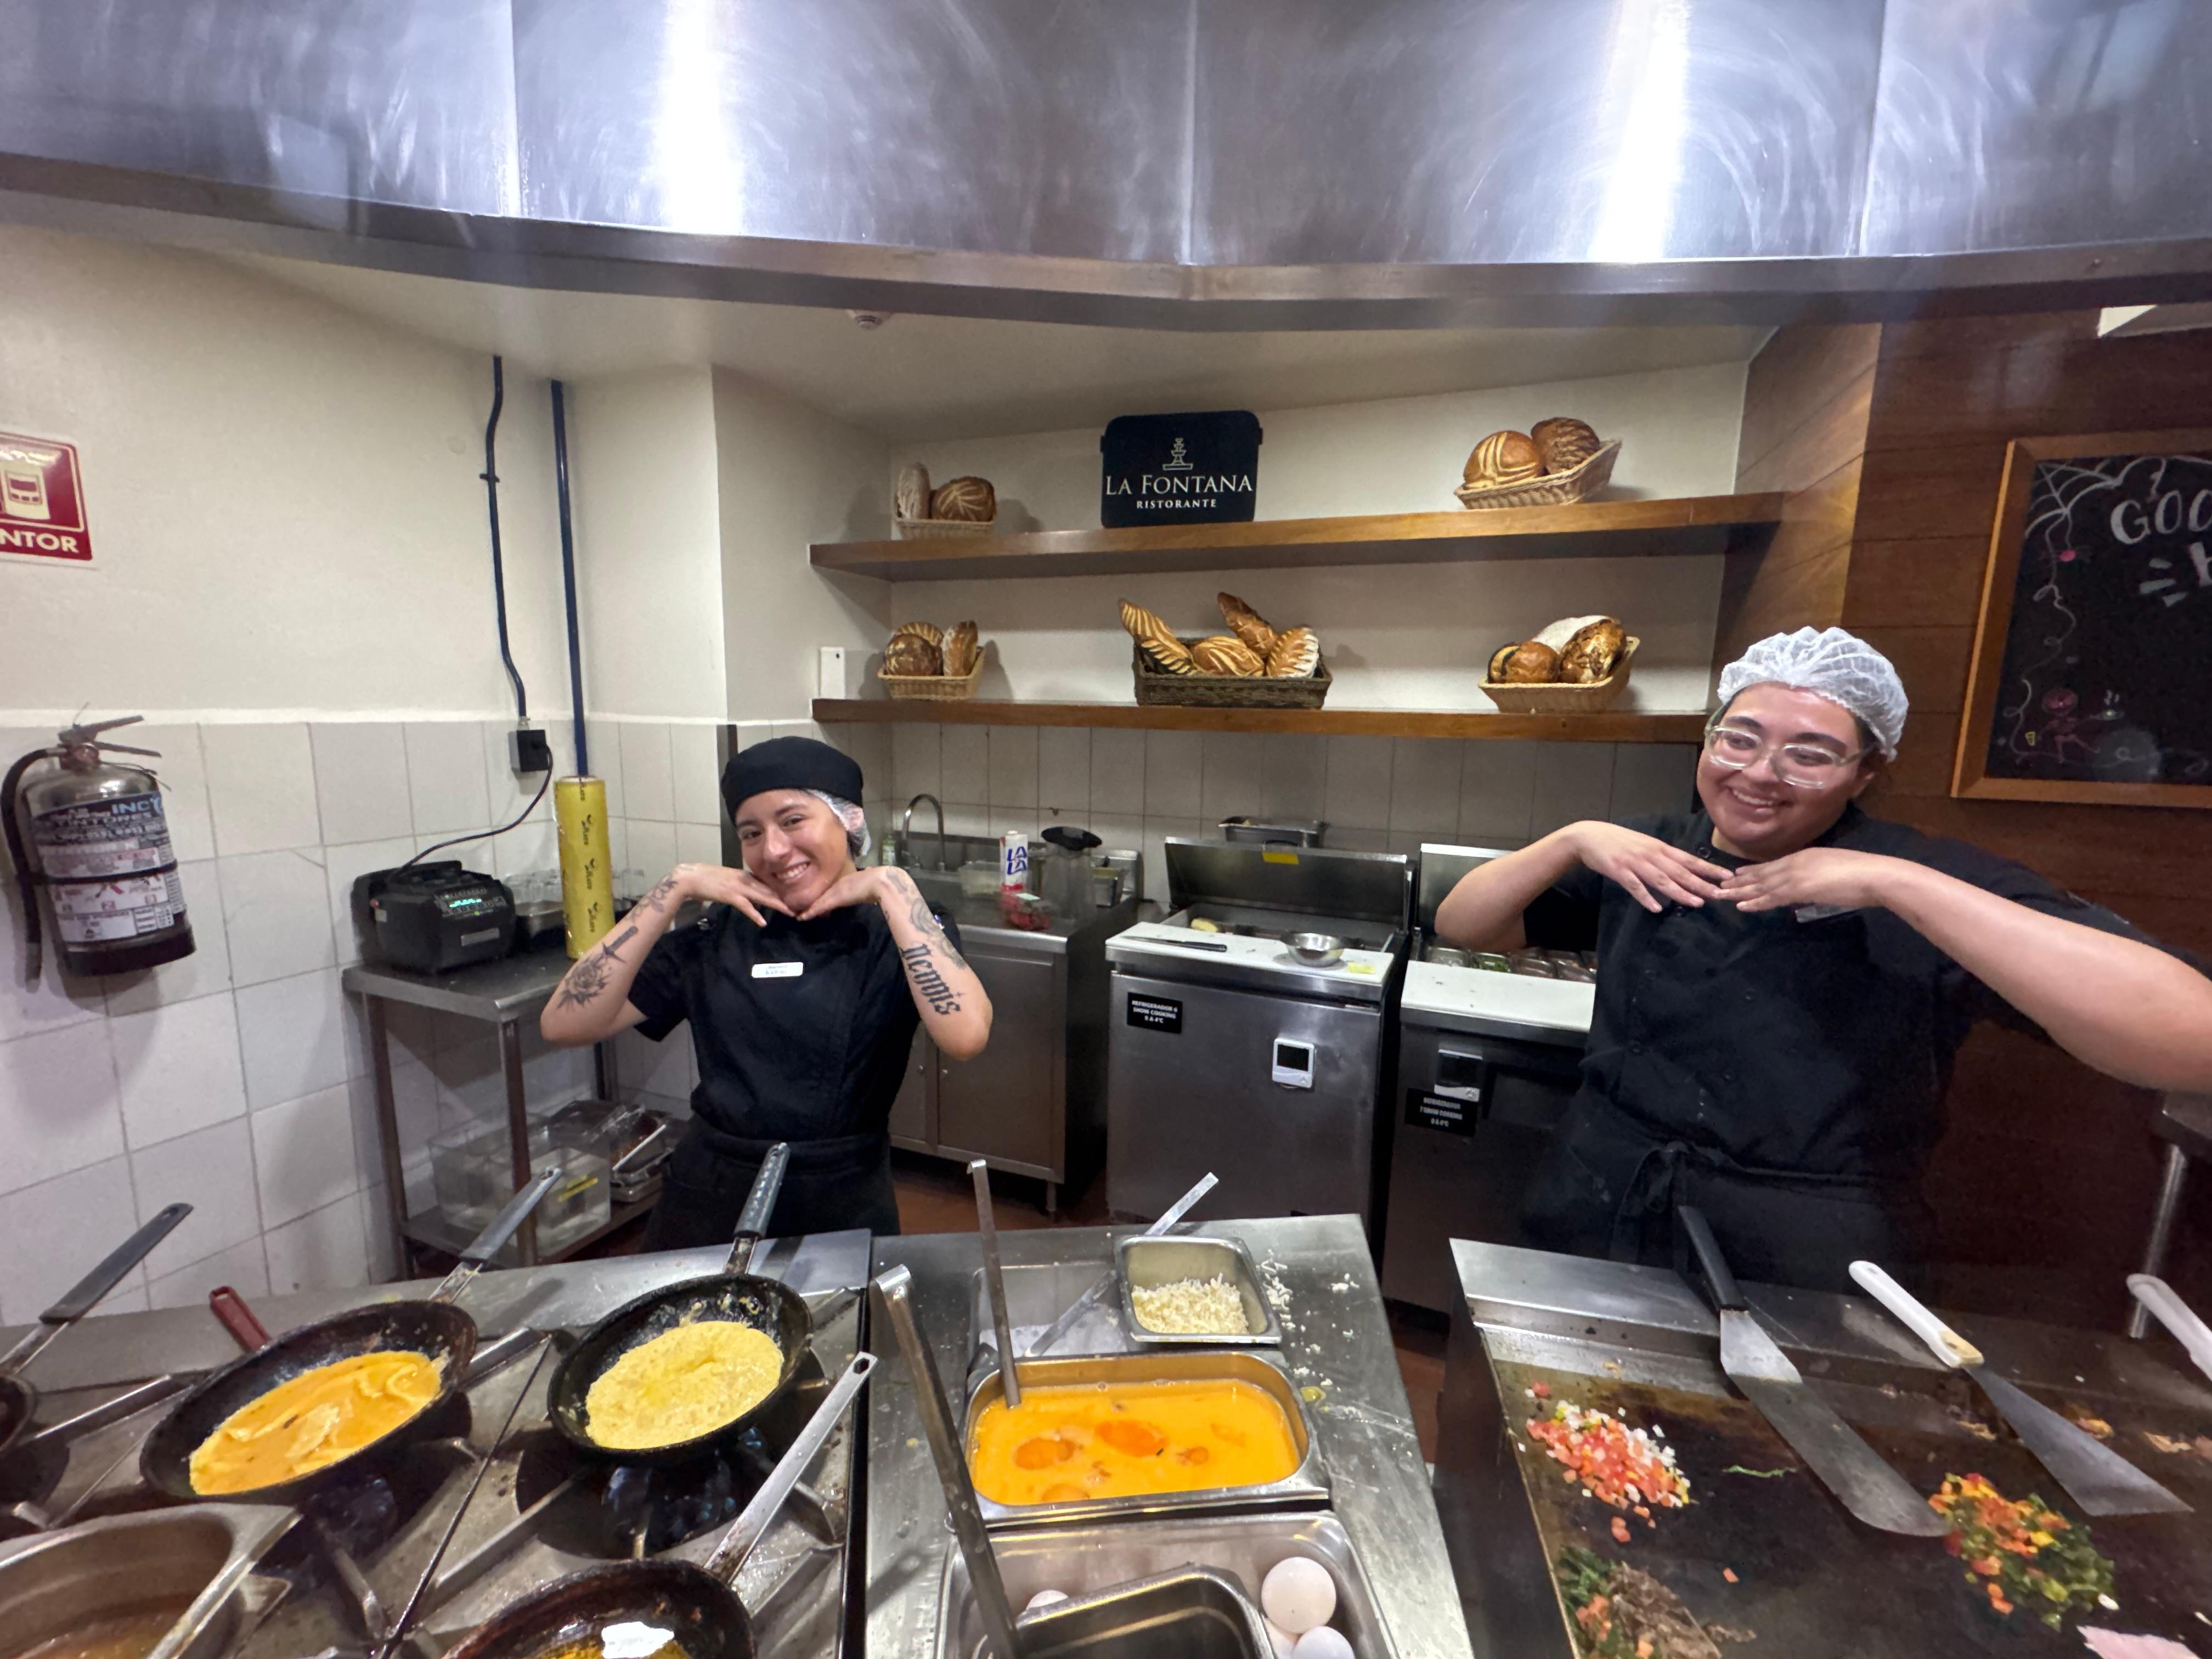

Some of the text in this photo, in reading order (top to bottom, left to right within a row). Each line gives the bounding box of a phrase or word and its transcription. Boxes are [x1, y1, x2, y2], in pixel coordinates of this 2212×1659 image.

[1106, 475, 1253, 495] LA FONTANA
[1136, 499, 1216, 509] RISTORANTE
